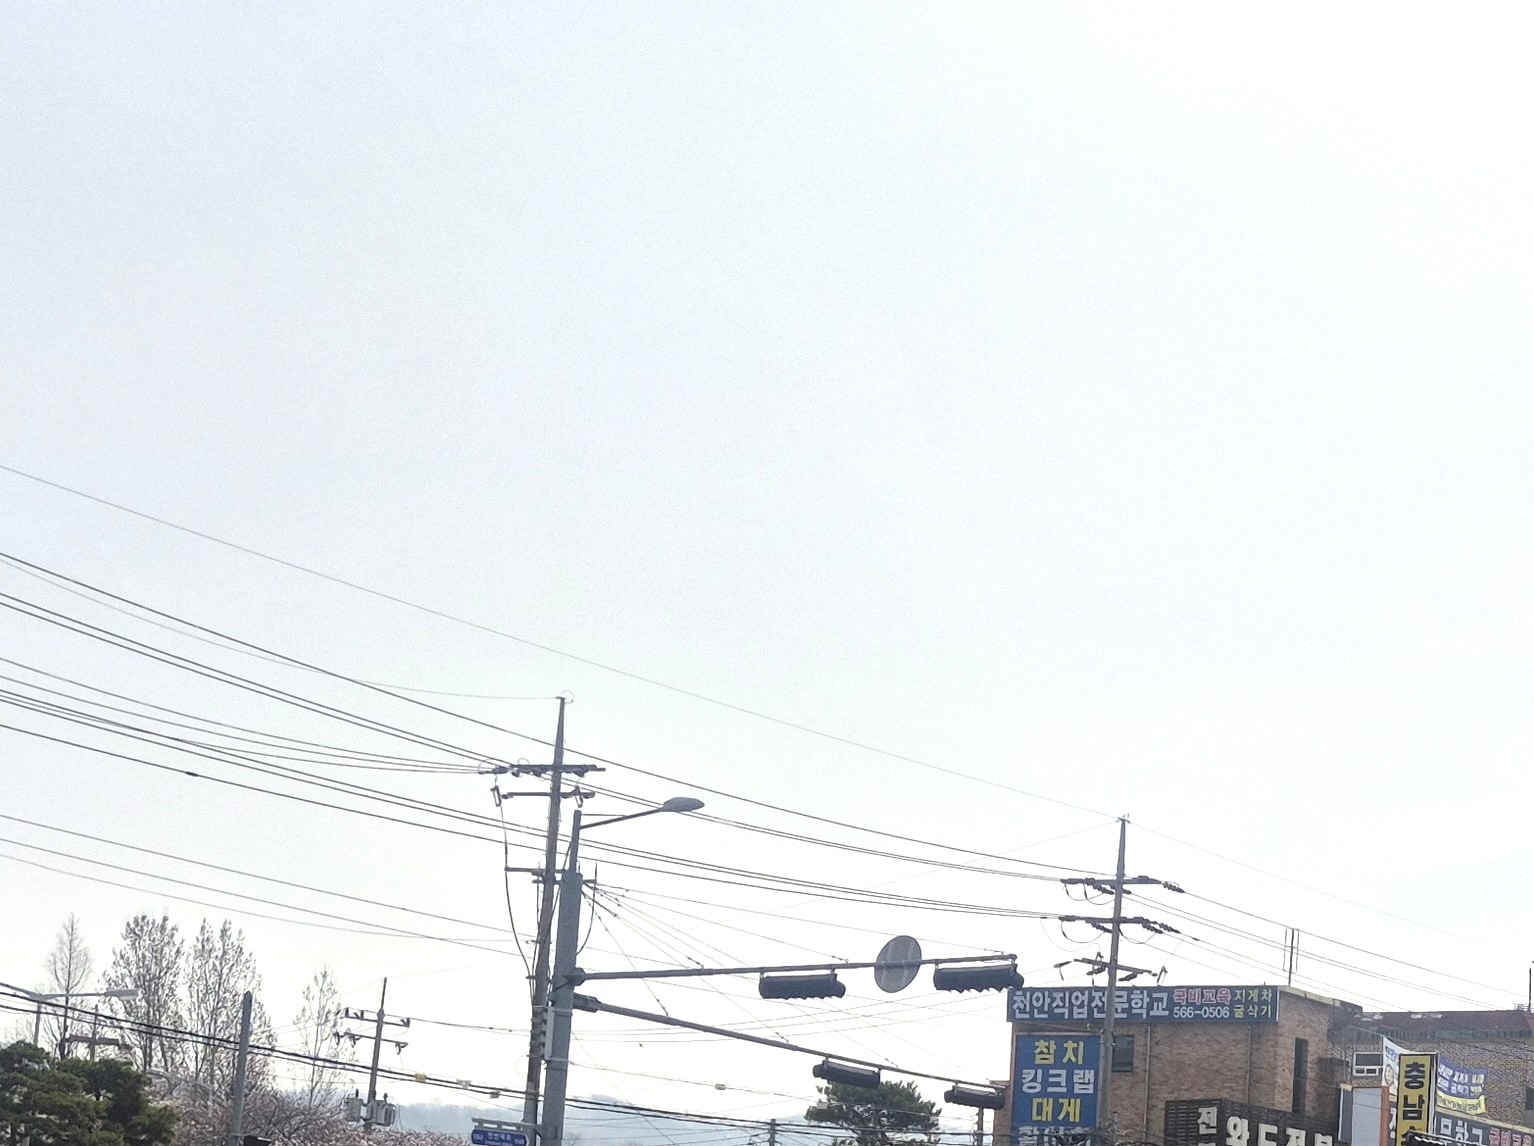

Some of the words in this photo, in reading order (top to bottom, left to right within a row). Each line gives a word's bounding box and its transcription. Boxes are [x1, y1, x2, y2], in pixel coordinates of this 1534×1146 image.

[1012, 988, 1169, 1020] 천안직업전문학교
[1172, 988, 1232, 1005] 국비교육
[1234, 987, 1273, 1003] 지게차
[1172, 1004, 1230, 1019] 566-0506
[1233, 1004, 1272, 1019] 굴삭기
[1034, 1039, 1084, 1065] 참치
[1021, 1068, 1095, 1094] 킹크랩
[1031, 1097, 1081, 1123] 대게
